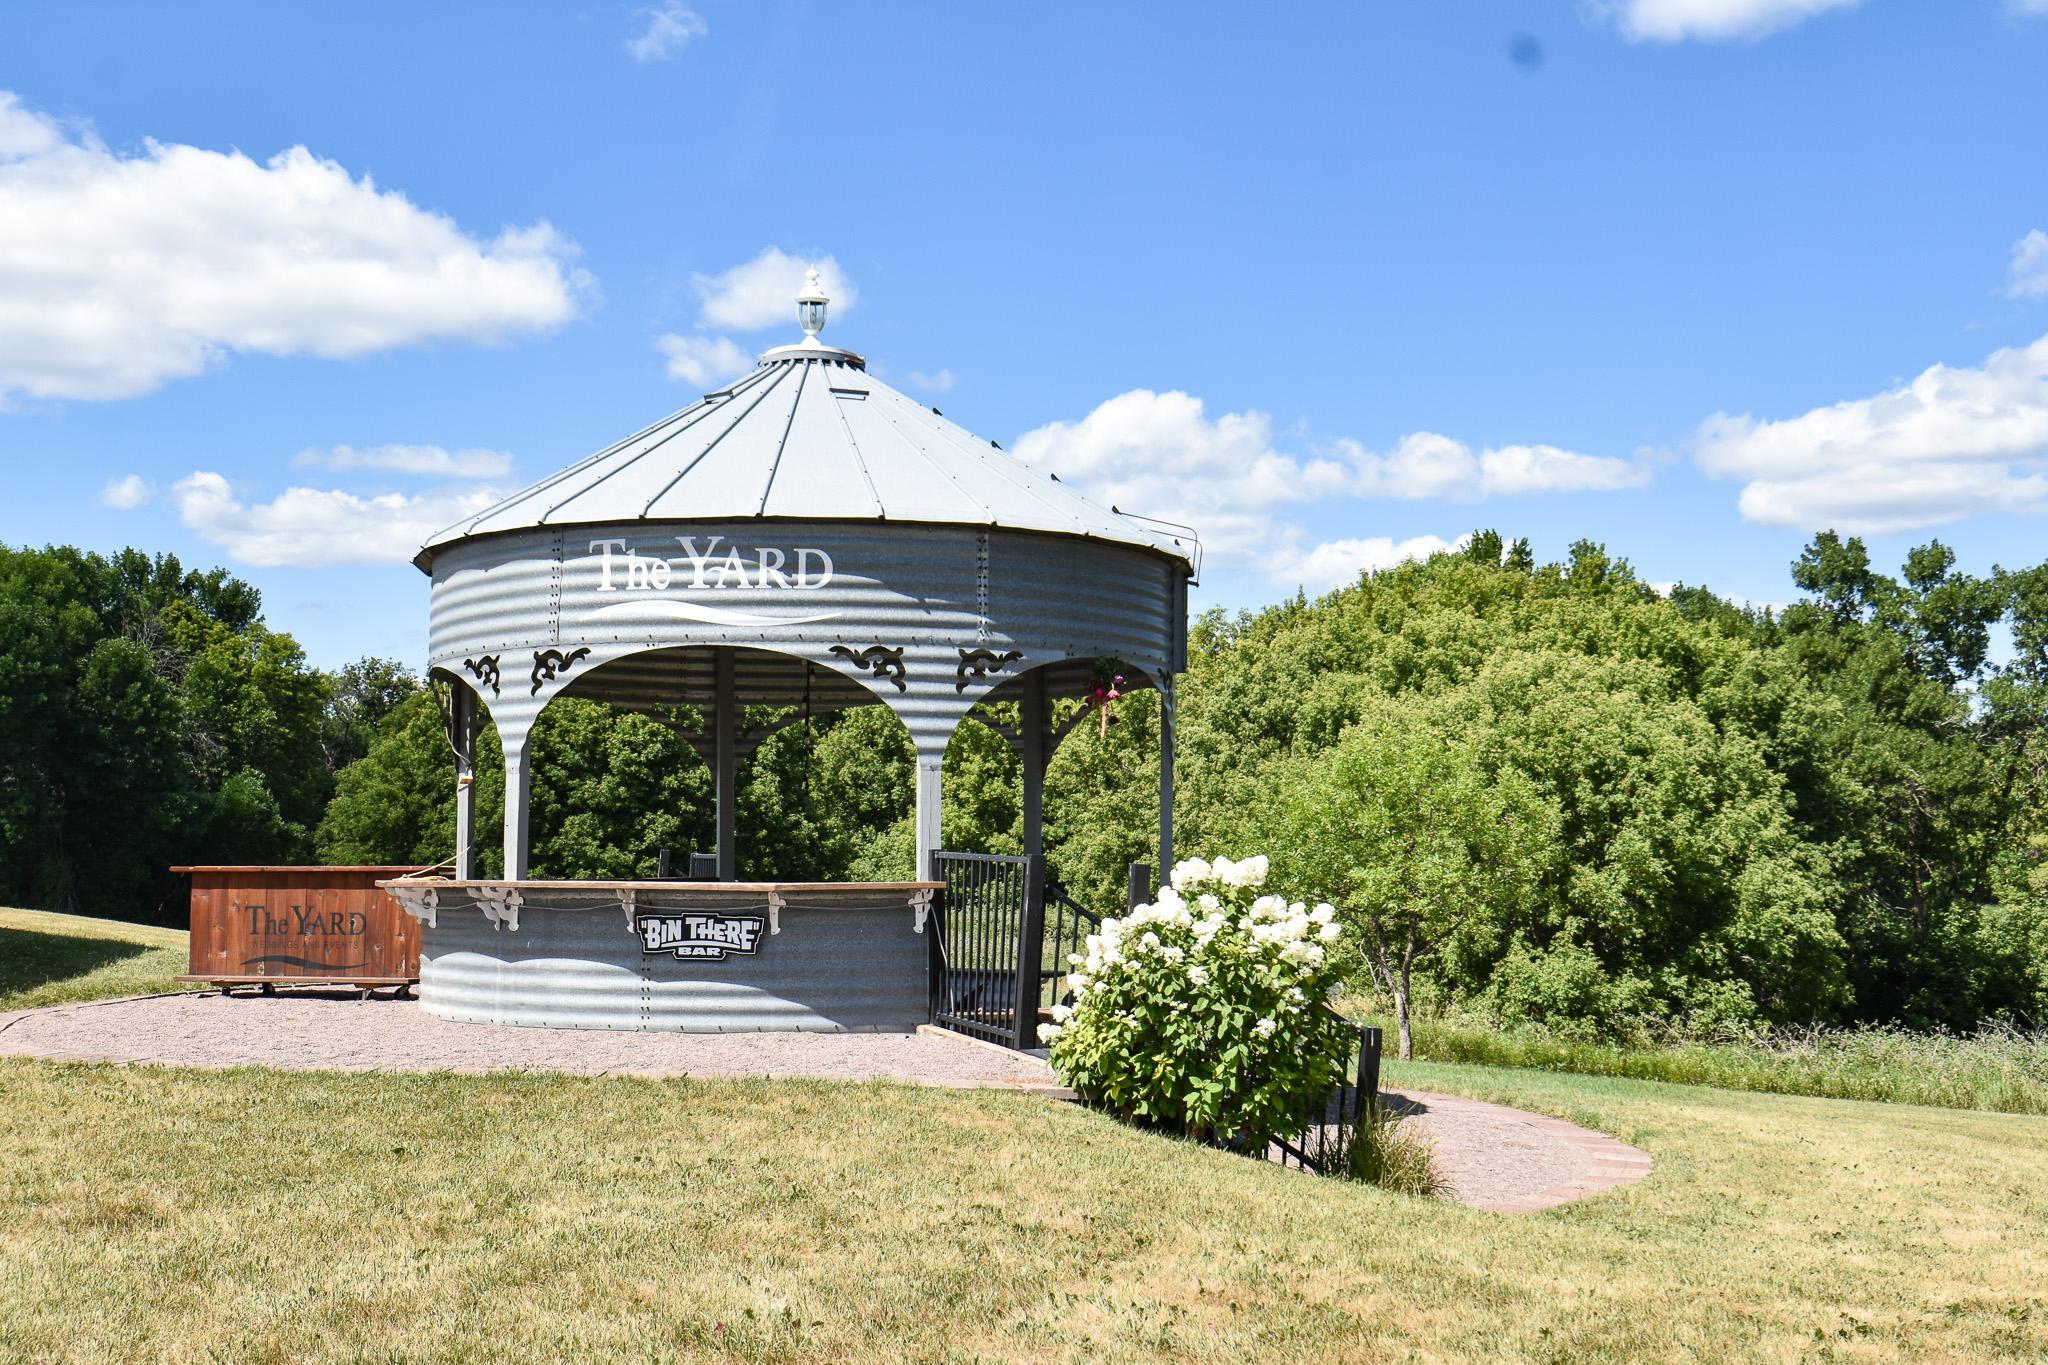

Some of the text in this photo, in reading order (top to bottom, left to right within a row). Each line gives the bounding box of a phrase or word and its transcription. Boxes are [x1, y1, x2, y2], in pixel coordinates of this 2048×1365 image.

[589, 536, 834, 591] The YARD
[244, 905, 367, 936] The YARD
[250, 940, 360, 950] WEDDINGS AND EVENTS
[678, 946, 721, 956] BAR
